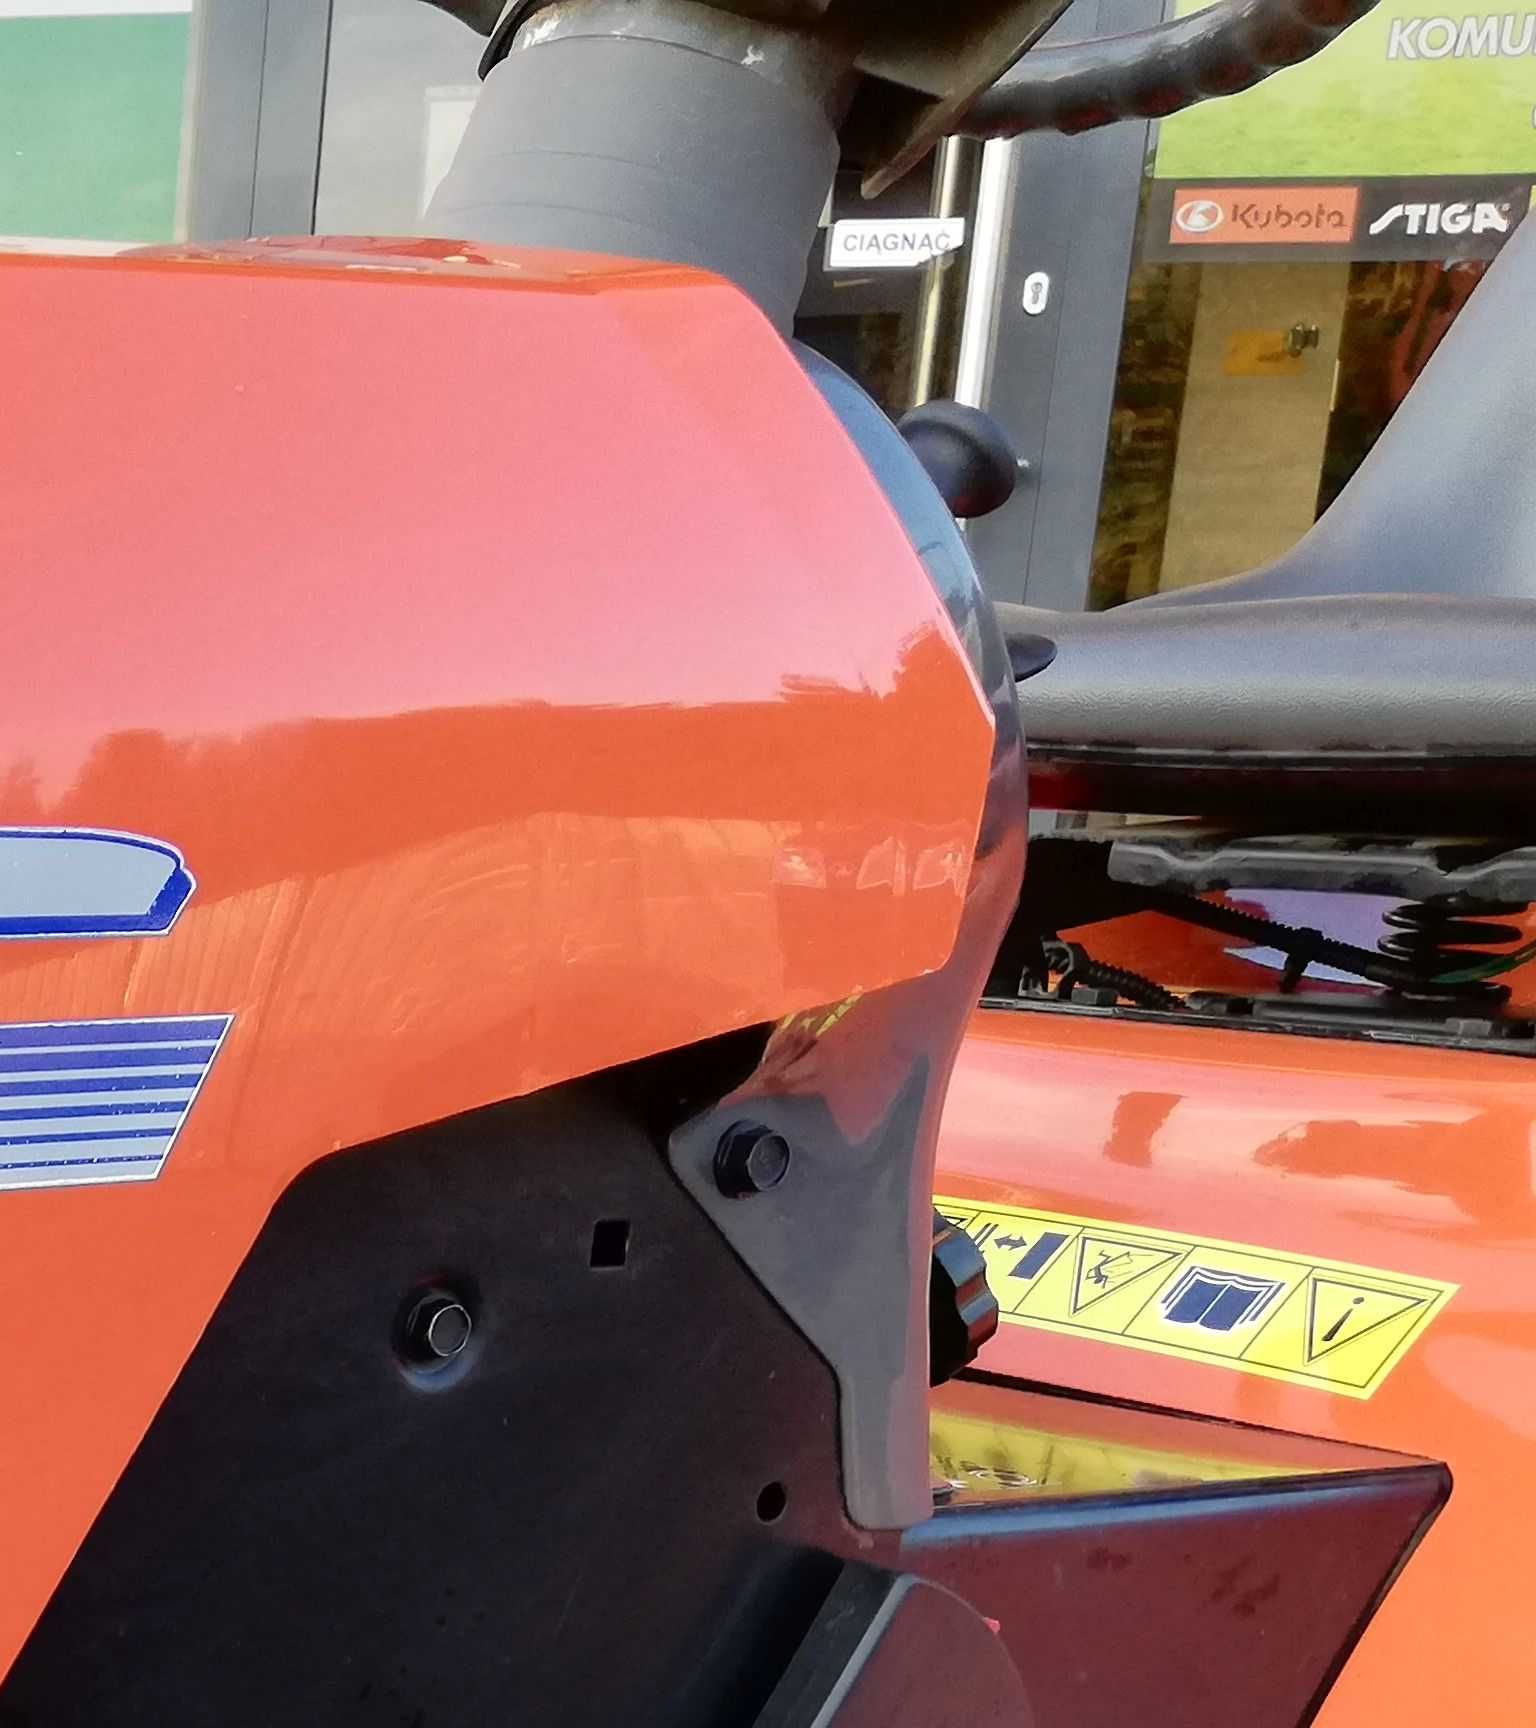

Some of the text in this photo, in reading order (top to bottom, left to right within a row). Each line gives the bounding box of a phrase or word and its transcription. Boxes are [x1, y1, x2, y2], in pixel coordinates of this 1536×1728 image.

[1386, 14, 1536, 60] KOMU
[1231, 203, 1347, 231] Kubota
[1369, 202, 1508, 235] STIGA
